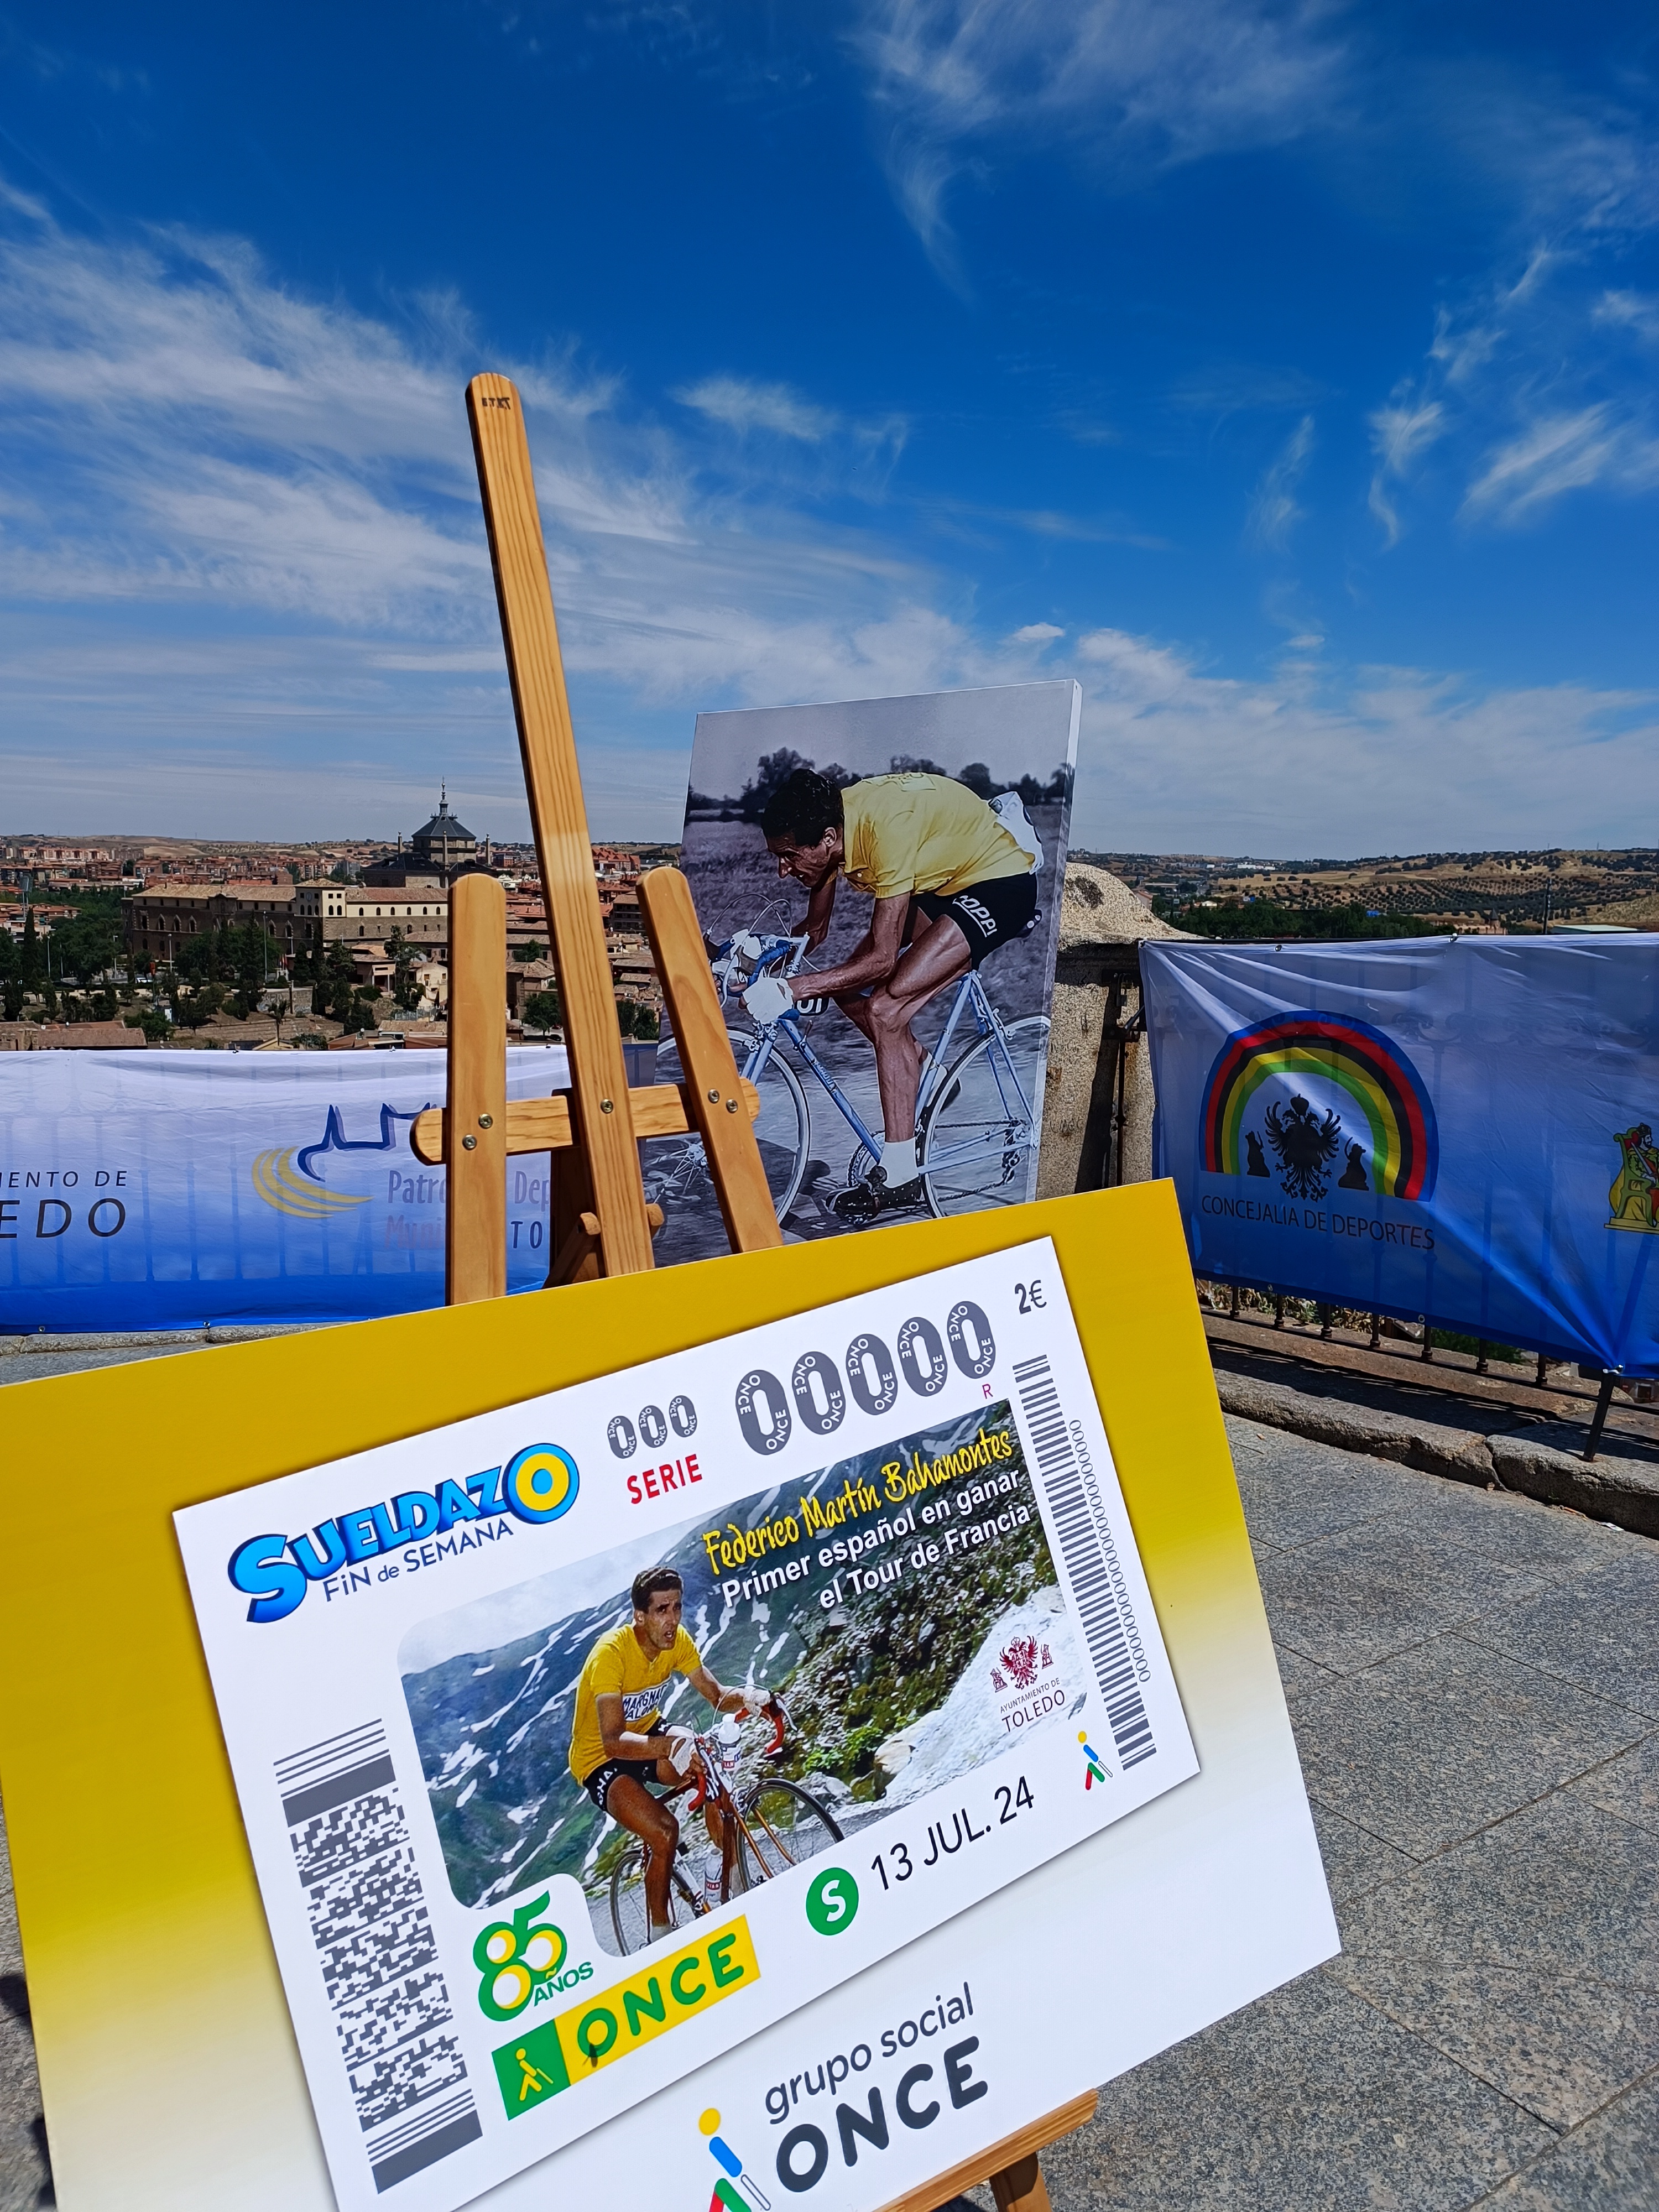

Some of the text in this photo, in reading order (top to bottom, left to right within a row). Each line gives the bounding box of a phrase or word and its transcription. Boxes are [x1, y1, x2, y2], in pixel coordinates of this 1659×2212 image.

[95, 1171, 127, 1186] DE
[510, 1220, 542, 1249] TO
[1202, 1195, 1435, 1250] CONCEJALIA DE DEPORTES
[1014, 1279, 1047, 1314] 2€
[900, 1322, 919, 1358] ONCE
[949, 1306, 968, 1342] ONCE
[794, 1357, 816, 1395] ONCE
[848, 1338, 868, 1376] ONCE
[926, 1355, 945, 1391] ONCE
[974, 1338, 993, 1374] ONCE
[607, 1301, 996, 1459] 000 00000
[737, 1375, 760, 1415] ONCE
[875, 1372, 895, 1410] ONCE
[982, 1384, 993, 1399] R
[639, 1407, 651, 1428] ONCE
[670, 1397, 682, 1417] ONCE
[684, 1415, 696, 1435] ONCE
[822, 1390, 842, 1430] ONCE
[608, 1418, 620, 1438] ONCE
[623, 1436, 635, 1456] ONCE
[654, 1425, 666, 1446] ONCE
[766, 1409, 788, 1449] ONCE
[627, 1454, 703, 1504] SERIE
[703, 1427, 1013, 1575] Federico Martín Bahamontes
[227, 1443, 580, 1623] SUELDAZO
[378, 1564, 399, 1582] de
[403, 1517, 513, 1572] SEMANA
[722, 1470, 1019, 1608] Primer español en ganar
[820, 1504, 1031, 1609] el Tour de Francia
[1000, 1677, 1060, 1714] AYUNTAMIENTO DE
[1001, 1690, 1065, 1732] TOLEDO
[871, 1776, 1034, 1890] 13 JUL. 24
[821, 1879, 846, 1922] S
[473, 1890, 567, 2022] 85
[533, 1961, 594, 2006] AÑOS
[577, 1933, 744, 2057] ONCE
[765, 1981, 973, 2125] grupo social
[776, 2036, 988, 2192] ONCE
